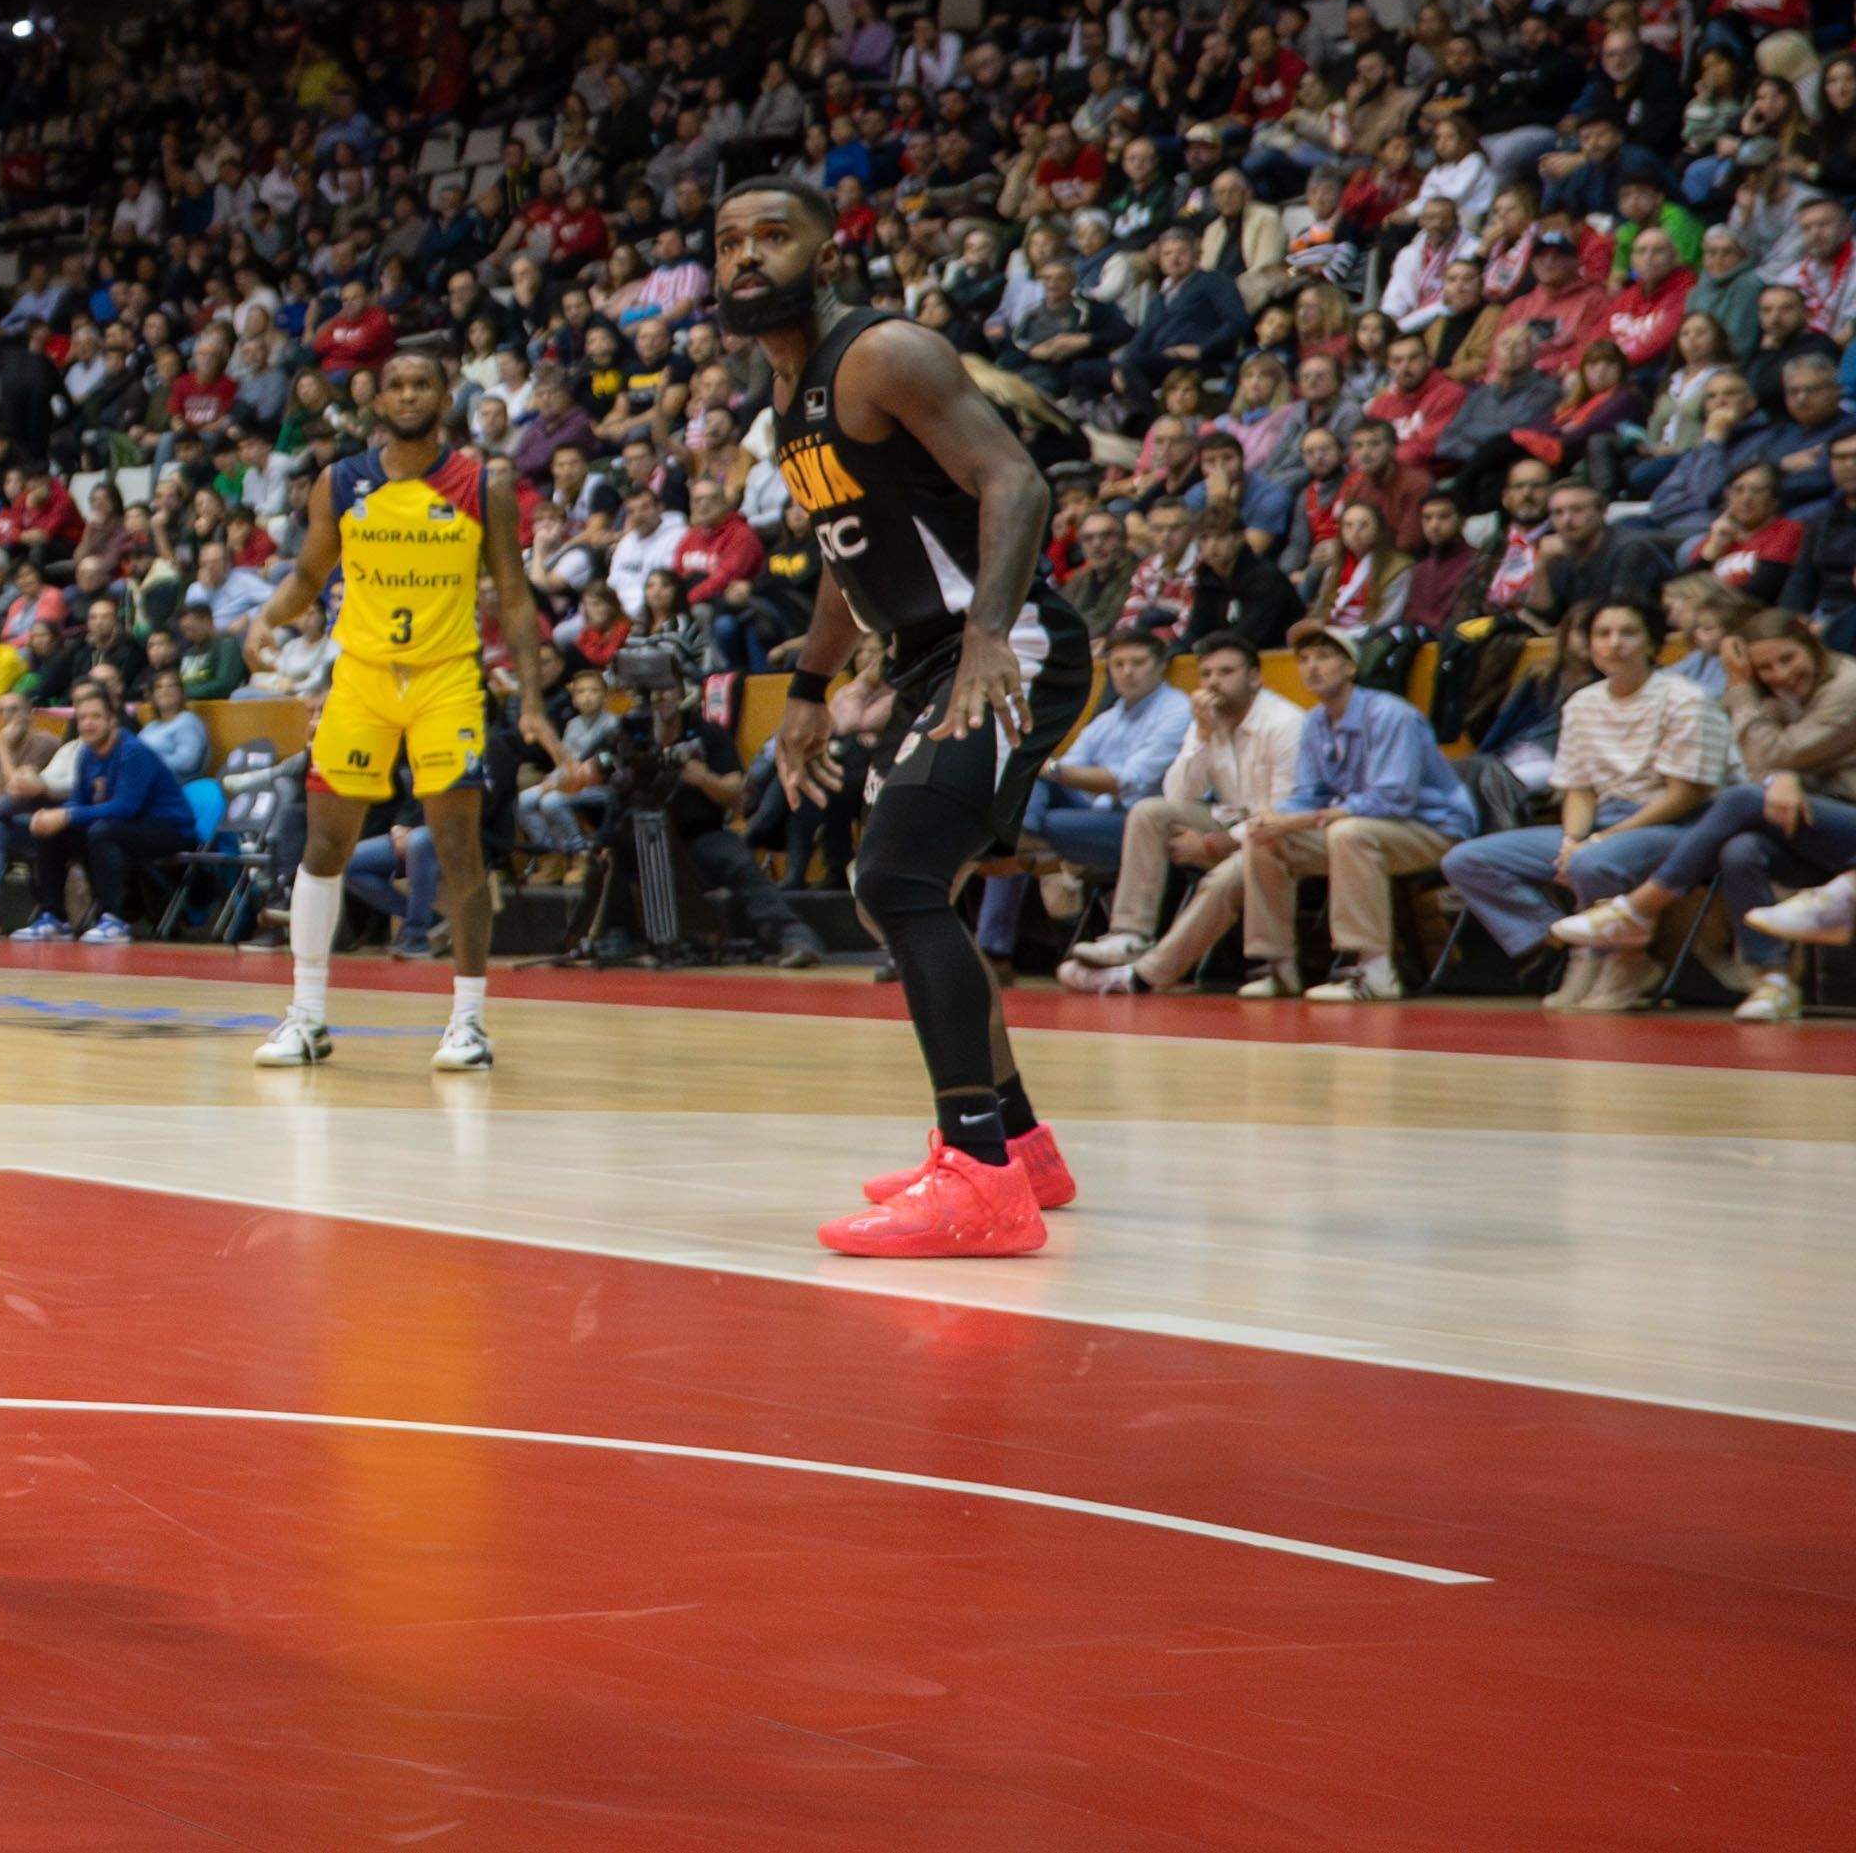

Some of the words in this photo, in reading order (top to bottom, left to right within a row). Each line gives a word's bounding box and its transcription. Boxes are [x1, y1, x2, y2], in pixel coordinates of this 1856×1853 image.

[361, 527, 467, 544] MORABANC
[369, 566, 462, 589] Andorra
[389, 606, 413, 645] 3
